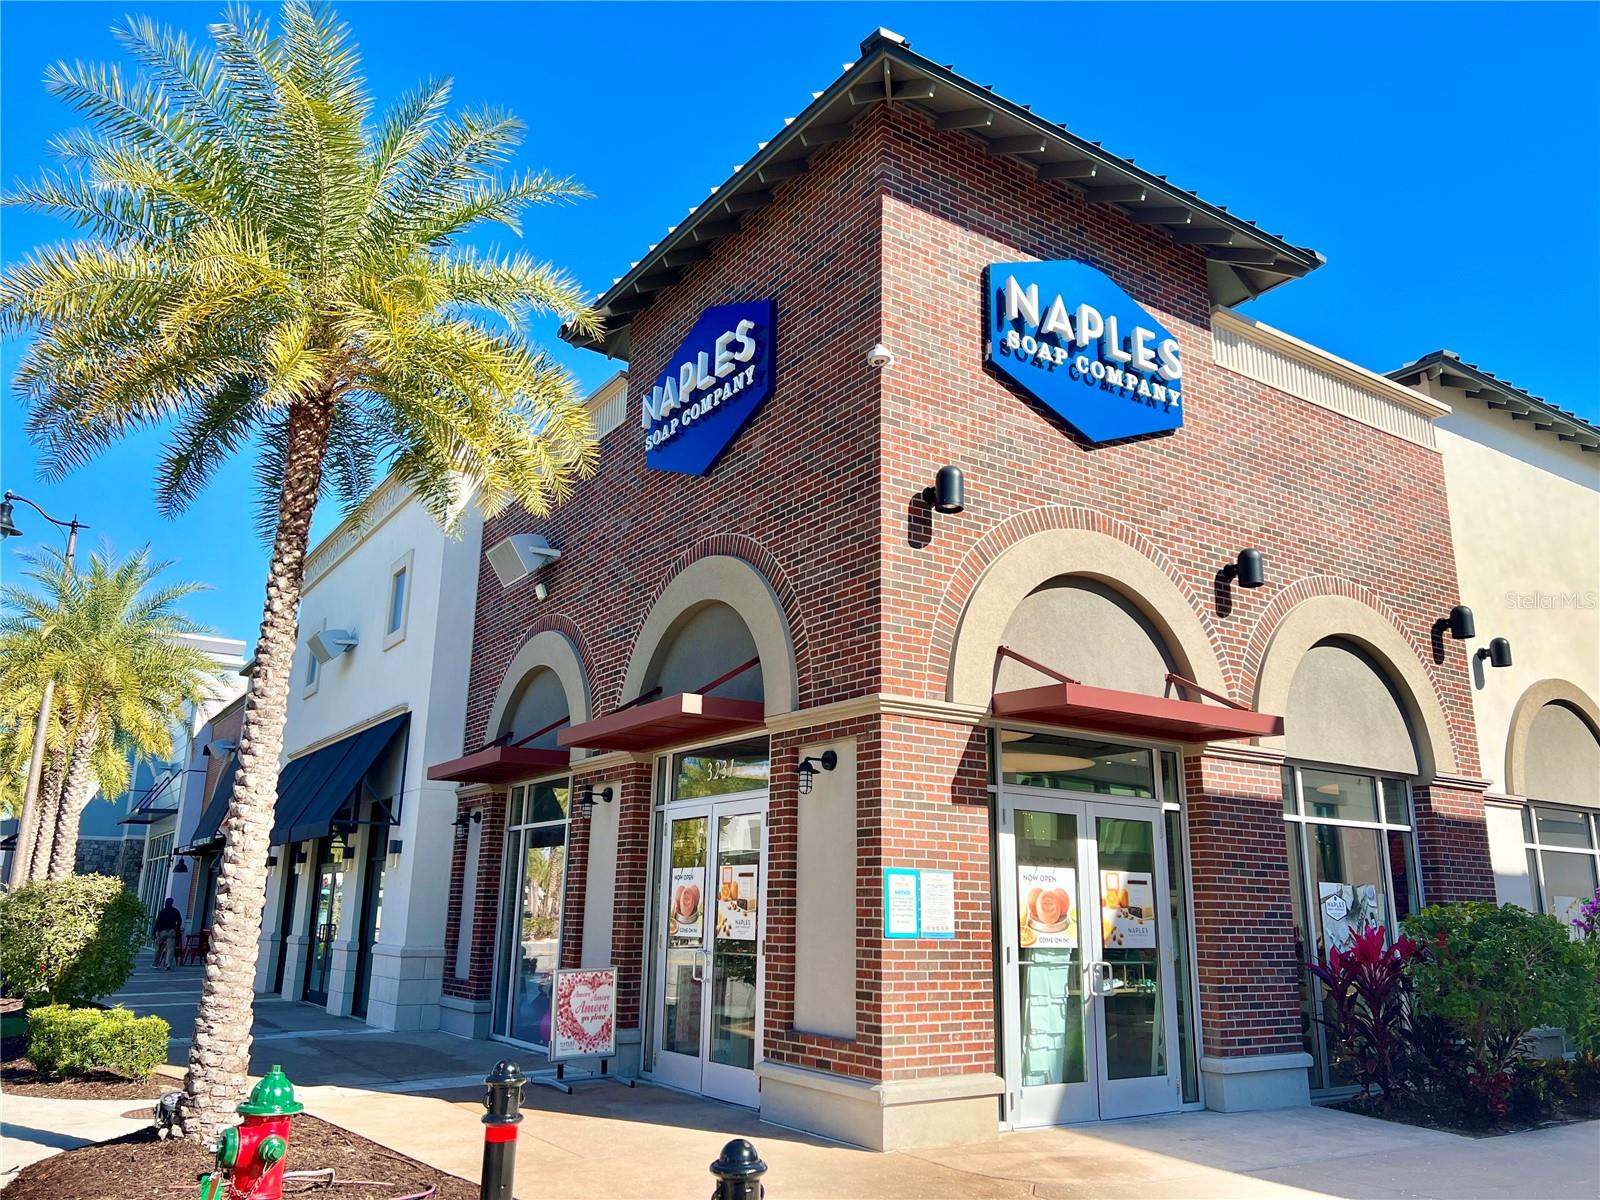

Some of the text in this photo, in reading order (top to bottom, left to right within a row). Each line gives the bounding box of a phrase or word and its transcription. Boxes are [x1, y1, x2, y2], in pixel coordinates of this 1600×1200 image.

[1006, 275, 1183, 381] NAPLES
[642, 319, 756, 429] NAPLES
[1006, 330, 1181, 407] SOAP COMPANY
[645, 364, 756, 451] SOAP COMPANY
[1023, 873, 1057, 882] NOW OPEN
[1038, 936, 1054, 944] COME
[575, 1001, 609, 1014] Amore
